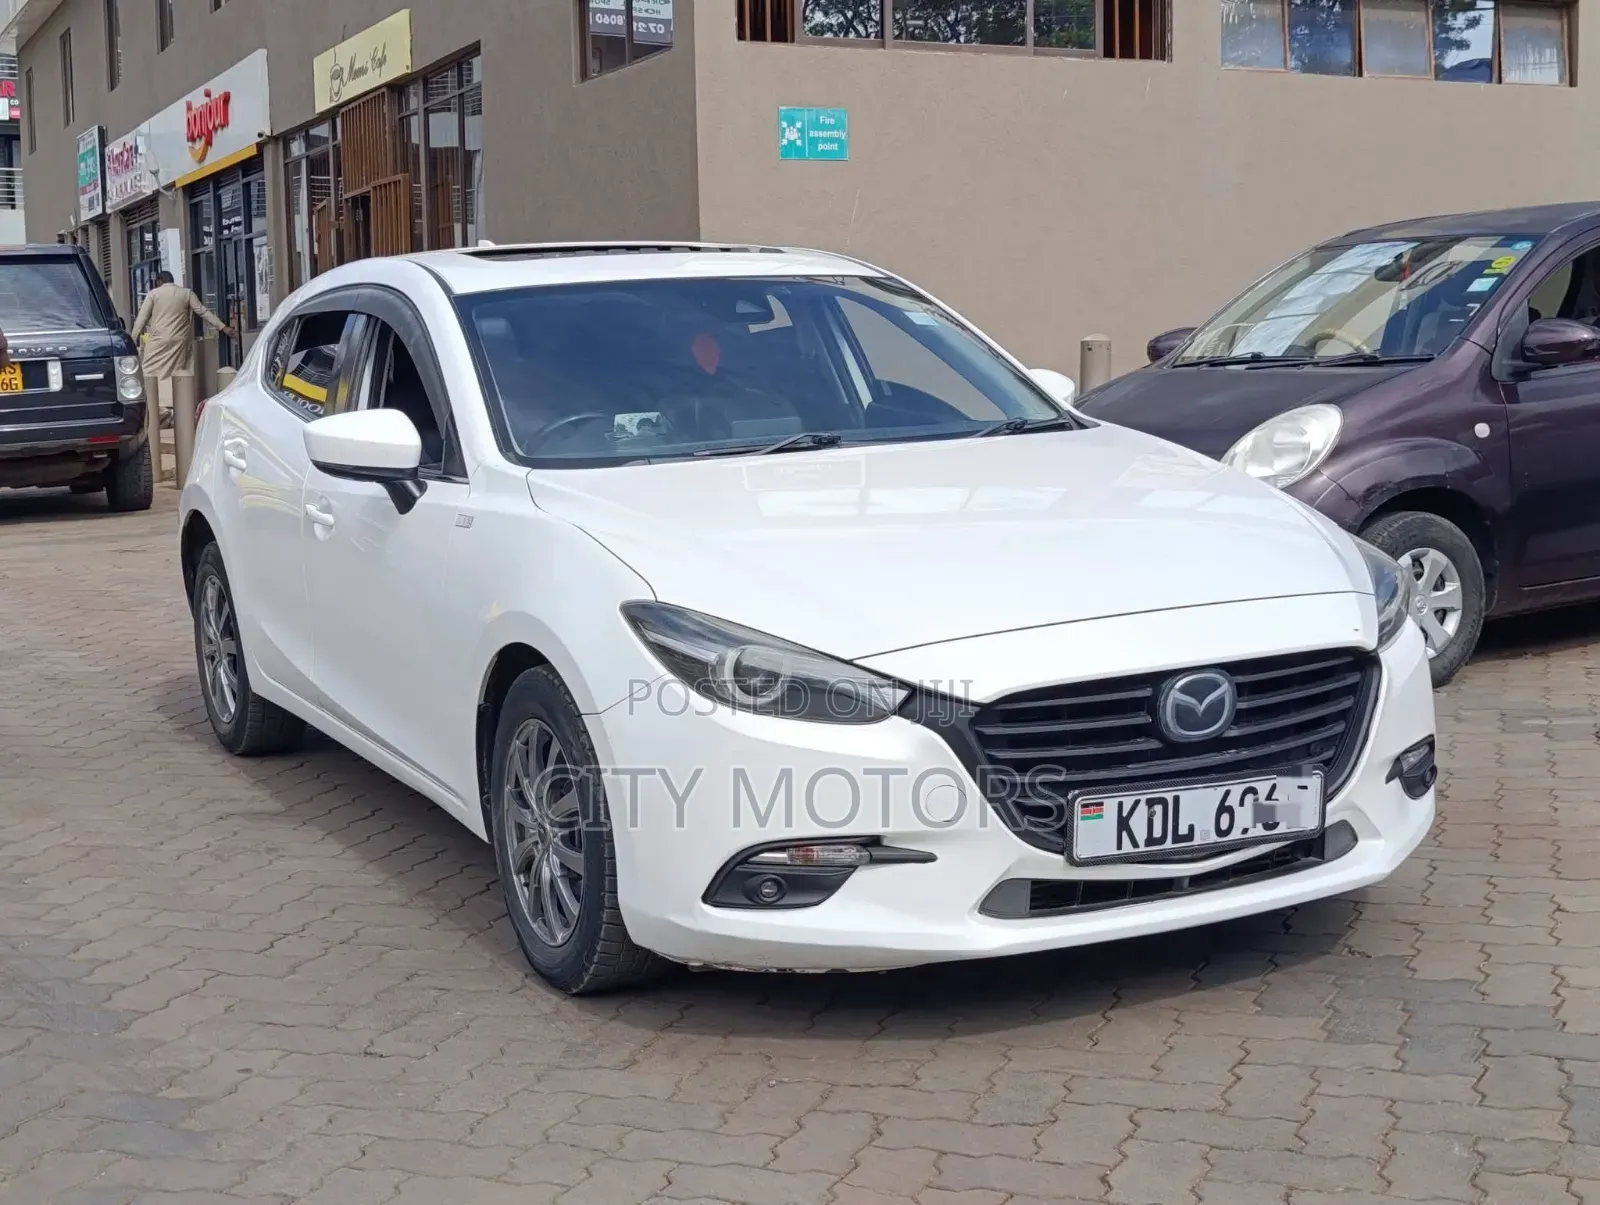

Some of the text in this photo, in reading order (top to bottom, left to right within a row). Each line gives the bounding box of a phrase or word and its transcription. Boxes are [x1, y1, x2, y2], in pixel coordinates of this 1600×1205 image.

[820, 116, 835, 125] Fire
[809, 130, 846, 140] assembly
[818, 143, 838, 152] point
[1115, 793, 1196, 851] KDL
